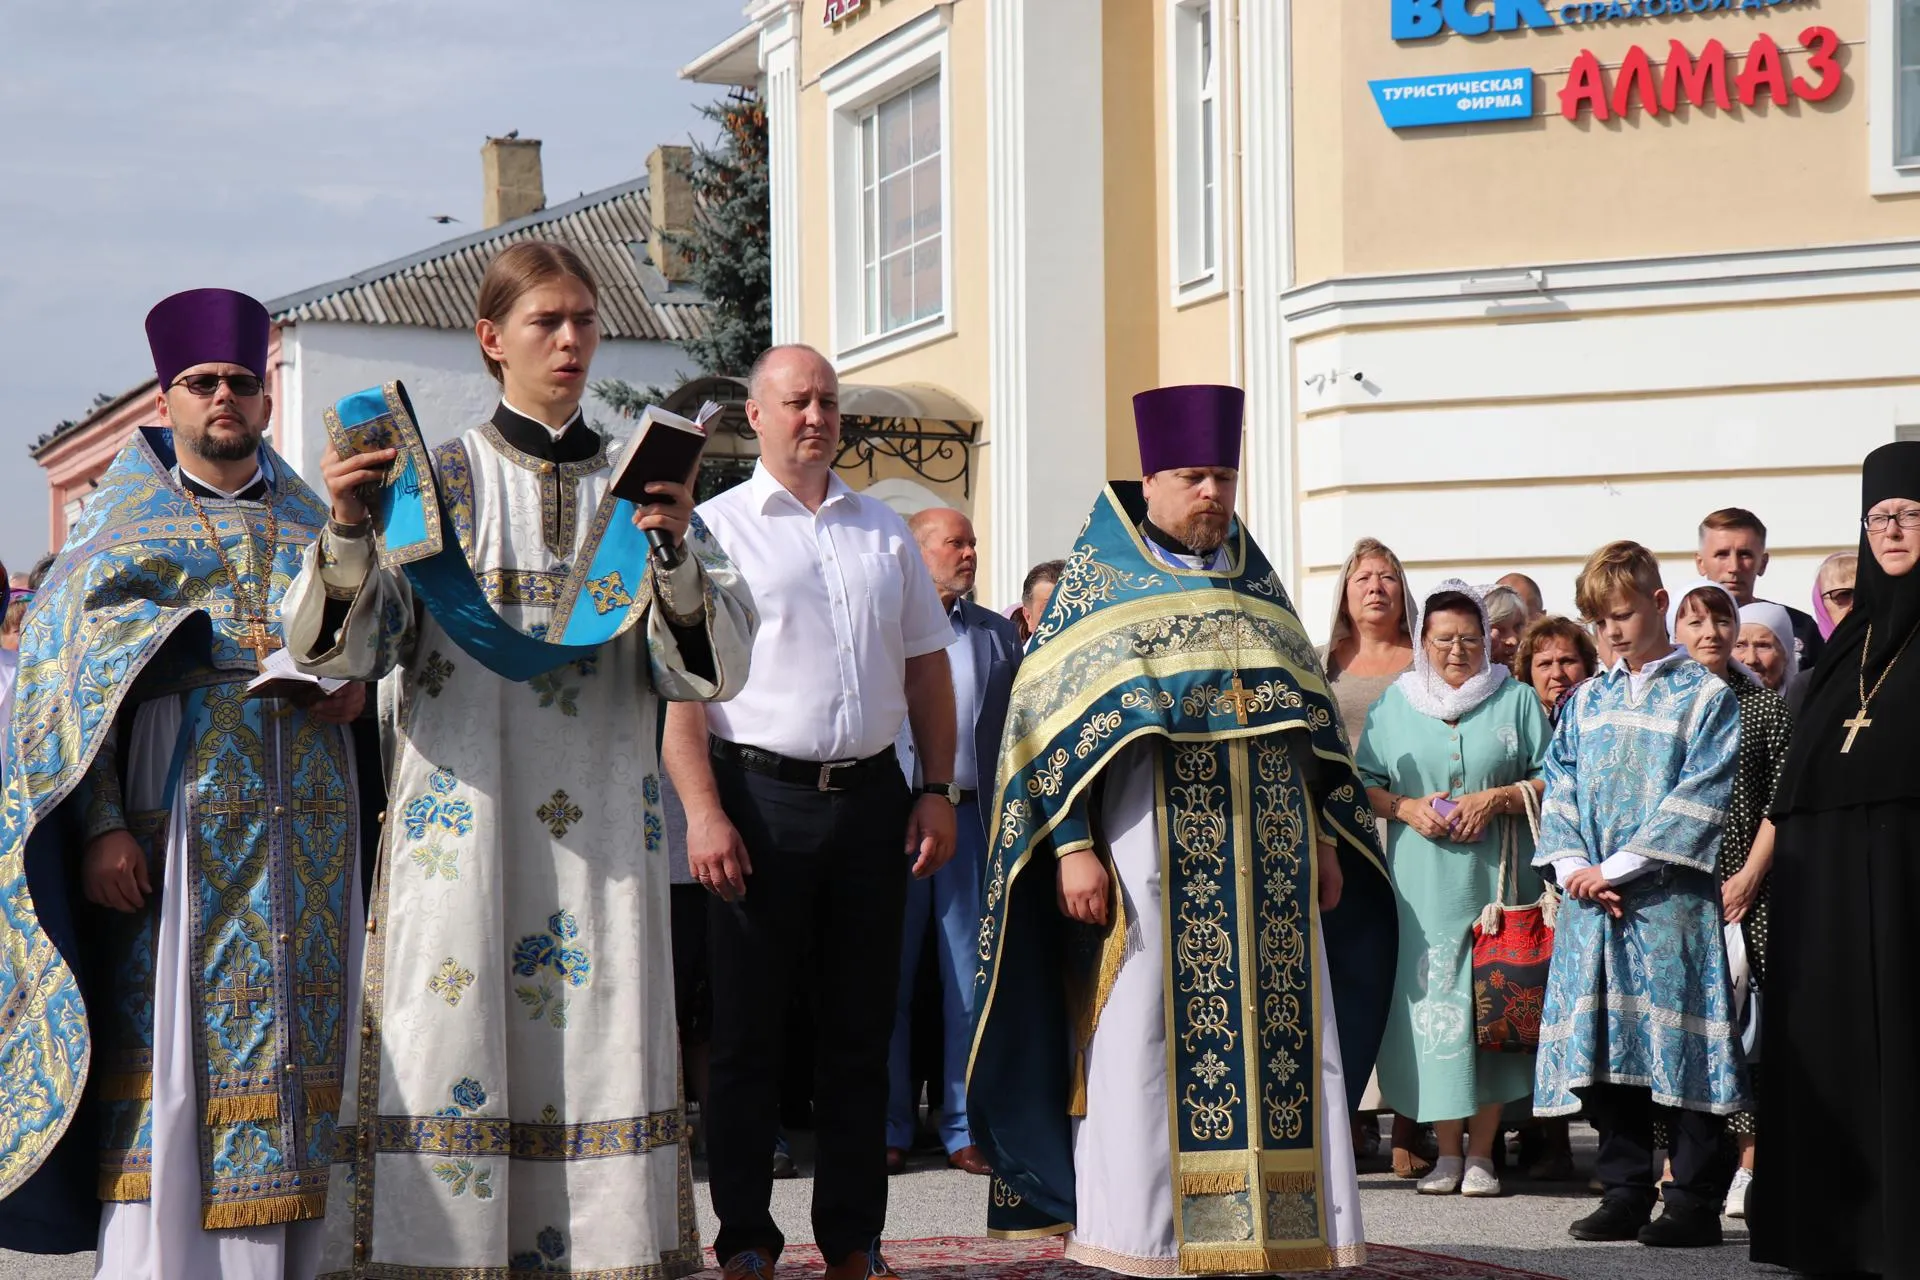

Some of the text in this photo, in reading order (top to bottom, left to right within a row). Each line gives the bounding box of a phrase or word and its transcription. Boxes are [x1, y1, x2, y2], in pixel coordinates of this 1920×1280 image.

[1557, 26, 1842, 121] АЛМАЗ
[1383, 77, 1524, 100] ТУРИСТИЧЕСКАЯ
[1456, 94, 1523, 111] ФИРМА
